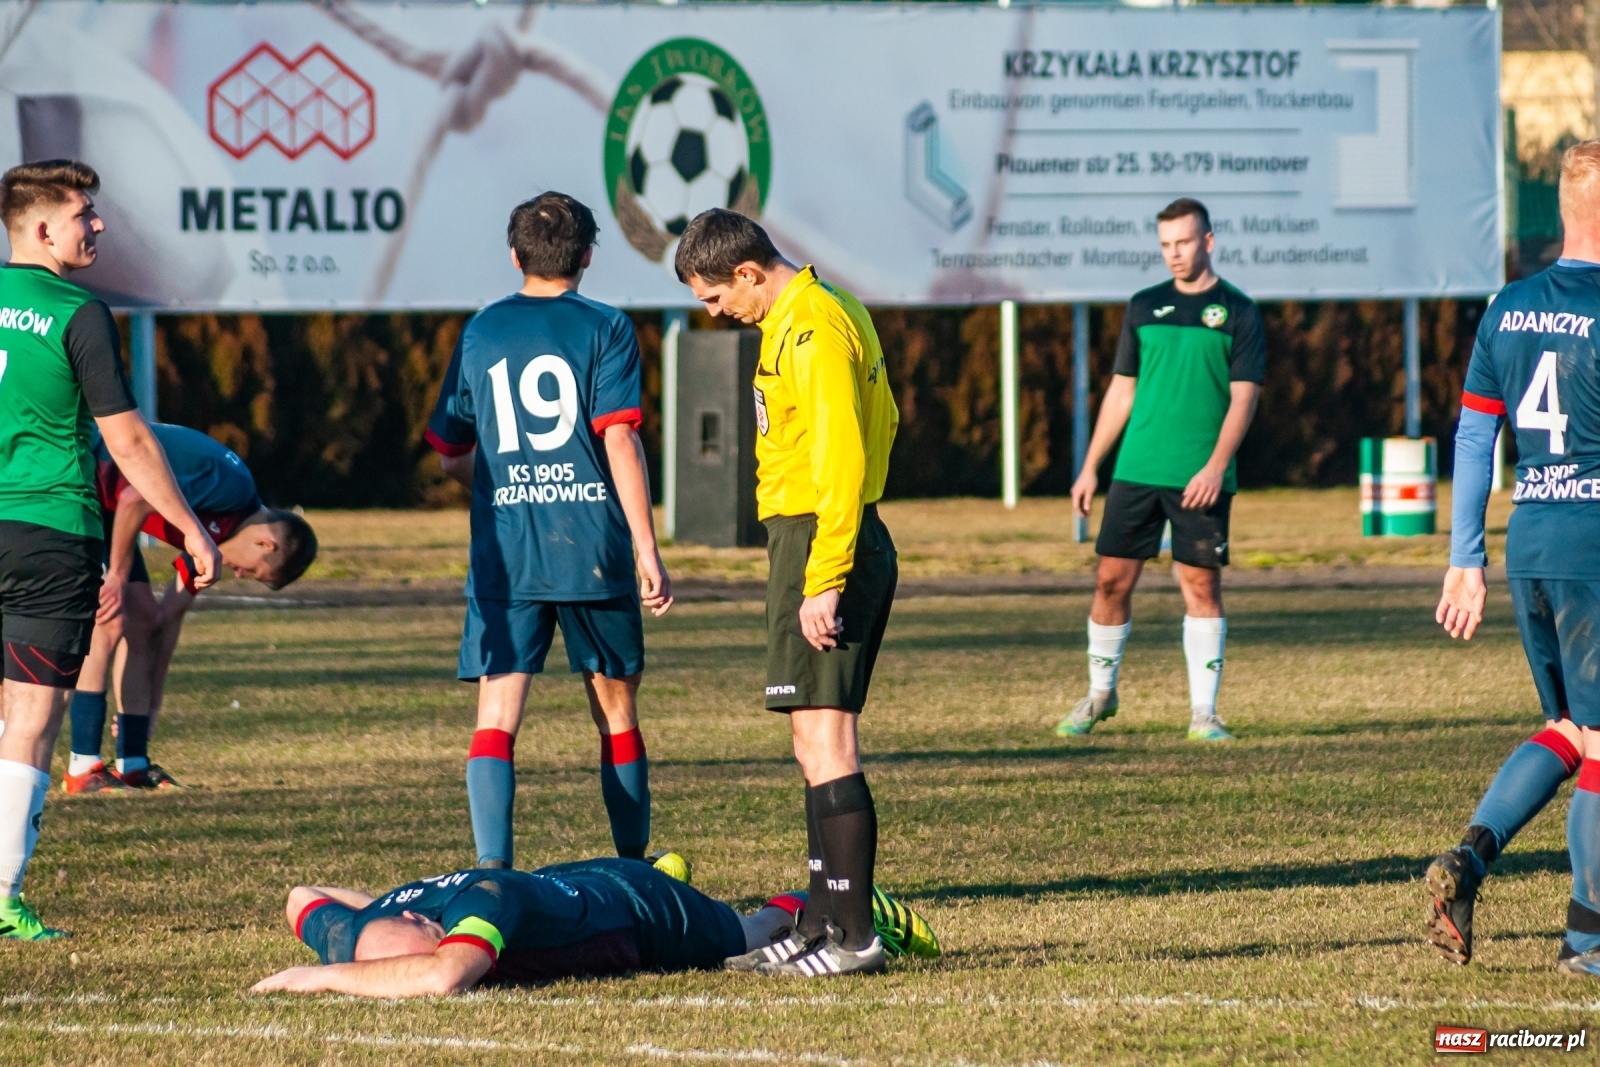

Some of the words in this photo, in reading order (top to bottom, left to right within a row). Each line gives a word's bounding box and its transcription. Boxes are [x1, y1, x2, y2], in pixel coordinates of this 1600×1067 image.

[1149, 49, 1301, 79] KRZYSZTOF
[1050, 93, 1144, 117] genormten
[1256, 87, 1354, 110] Trockenbau
[996, 153, 1081, 175] Plauener
[1085, 155, 1111, 174] str
[1219, 152, 1309, 173] Hannover
[180, 187, 405, 232] METALIO
[985, 215, 1054, 238] Fenster,
[1242, 214, 1320, 234] Markisen
[249, 249, 281, 279] Sp.
[285, 255, 298, 273] z
[302, 254, 341, 274] o.o.
[1219, 246, 1249, 265] Art,
[1253, 244, 1369, 266] Kundendienst
[0, 307, 54, 336] RKÓW
[1499, 311, 1595, 338] ADAMCZYK
[487, 354, 578, 454] 19
[1516, 351, 1568, 455] 4
[508, 464, 531, 483] KS
[534, 463, 575, 483] 1905
